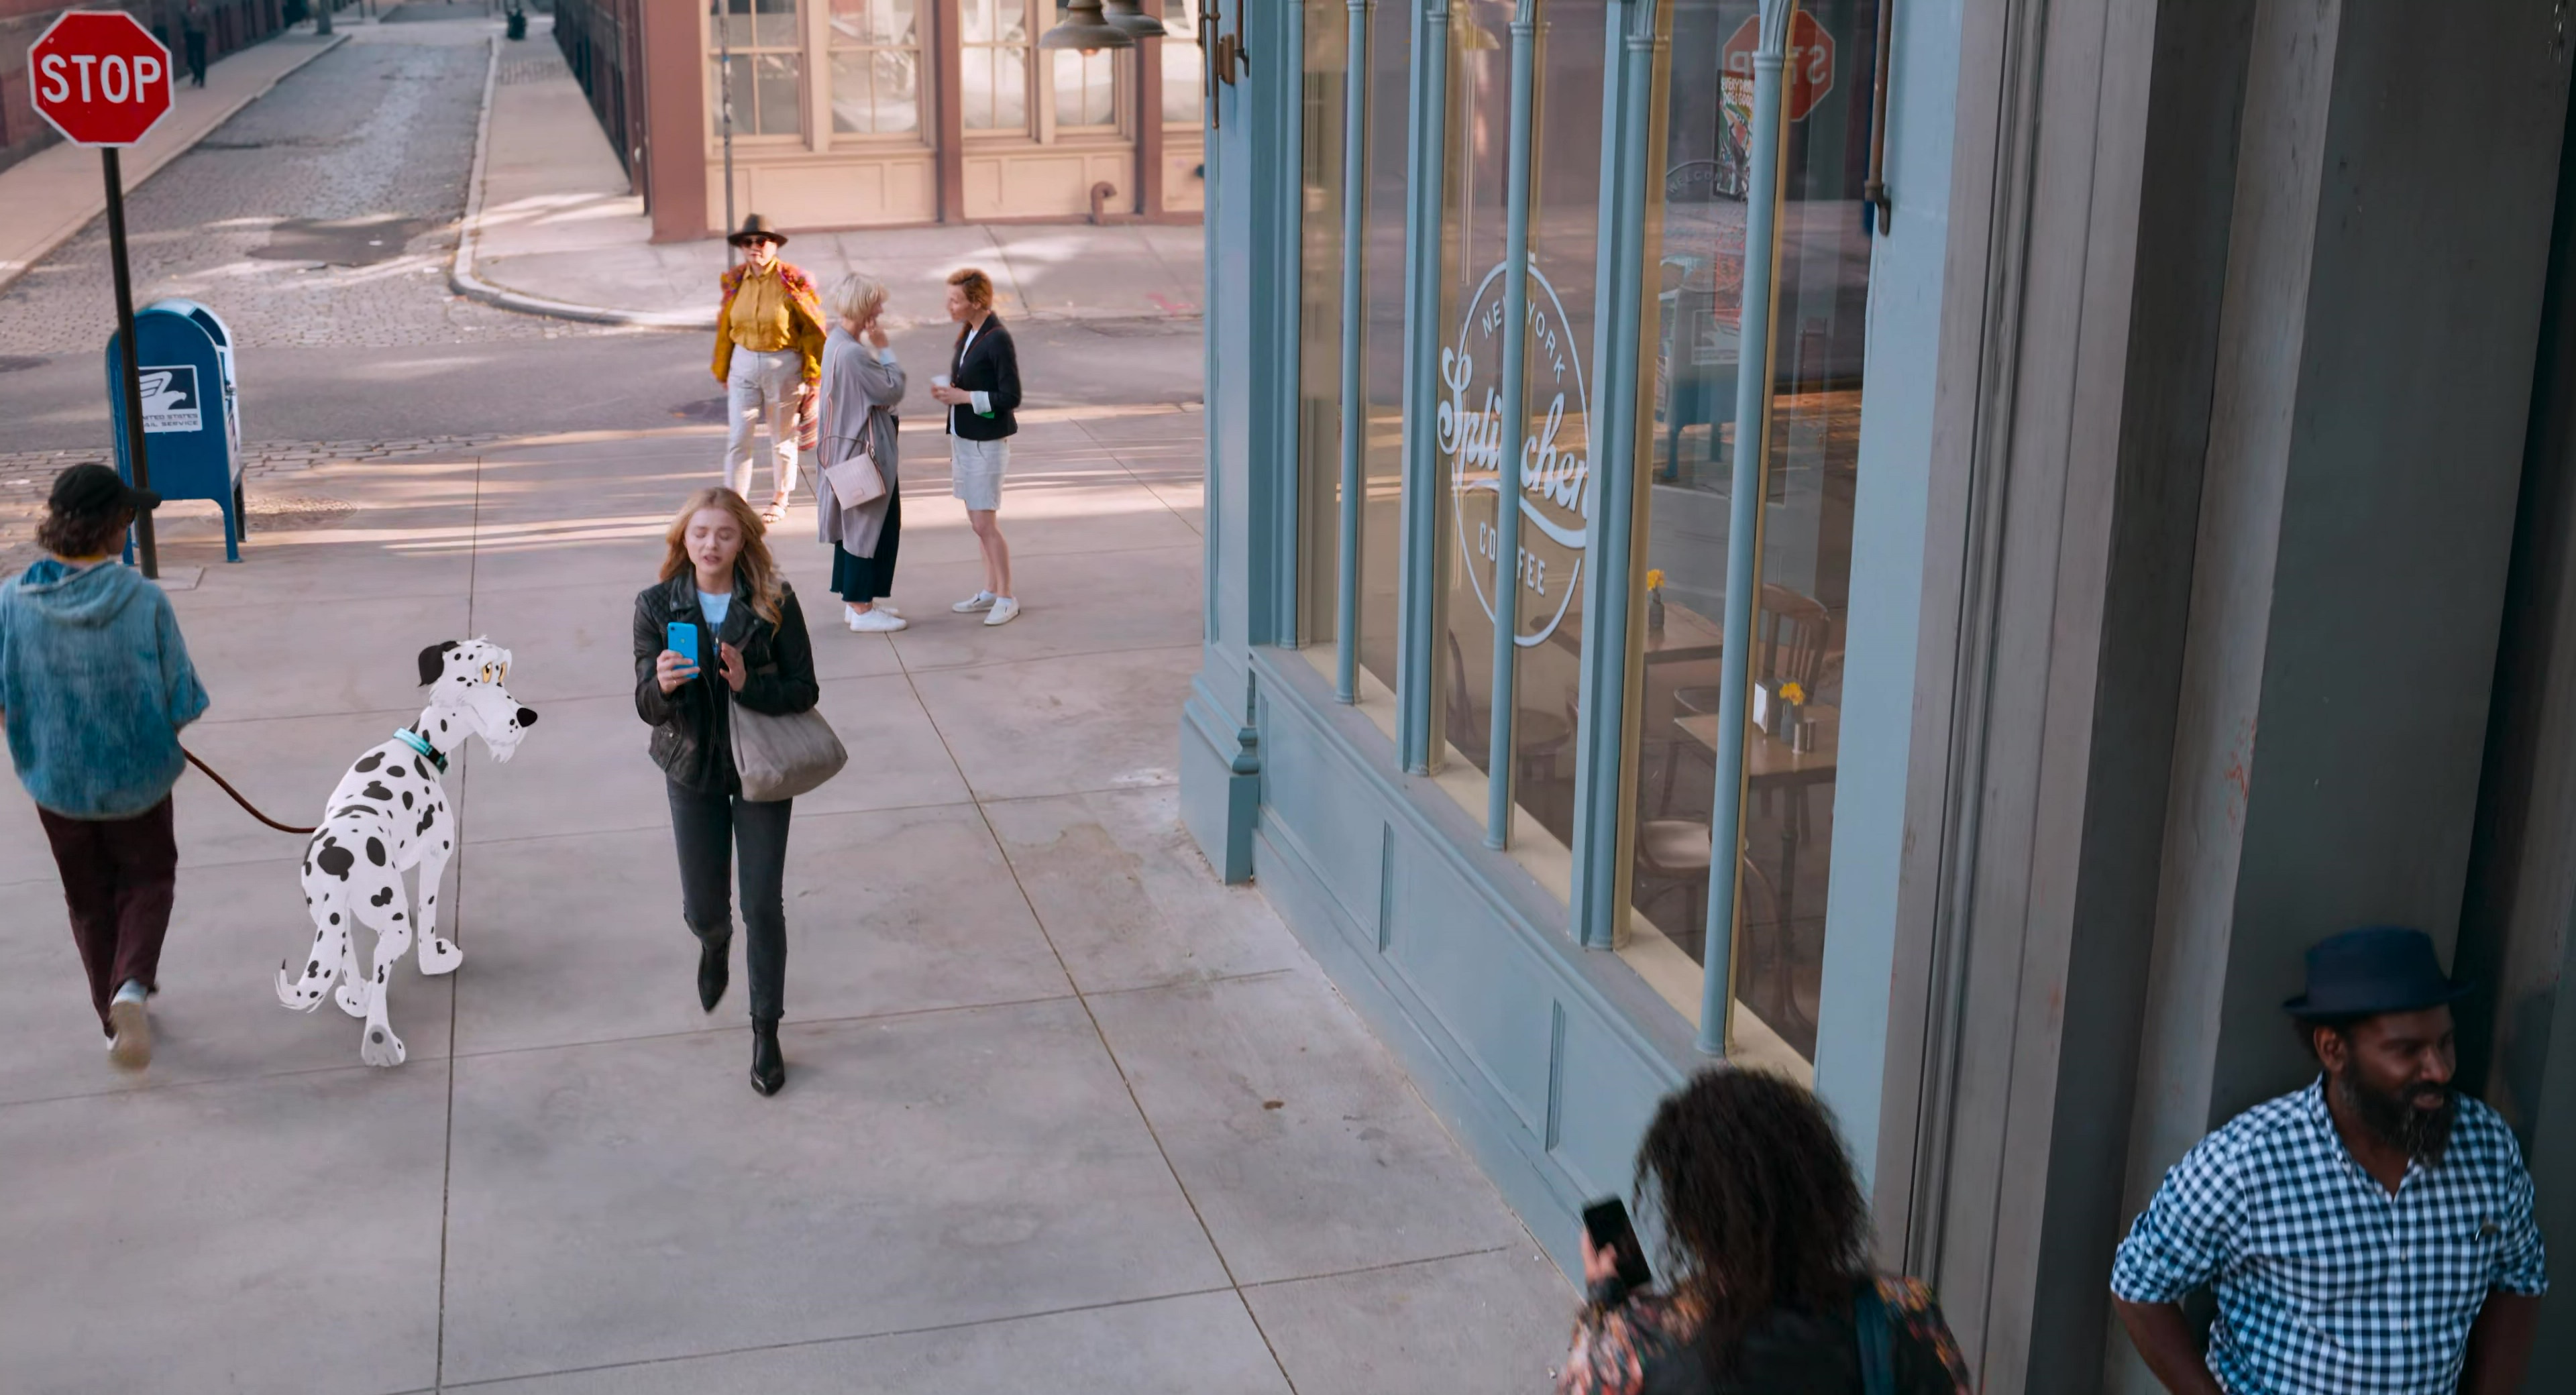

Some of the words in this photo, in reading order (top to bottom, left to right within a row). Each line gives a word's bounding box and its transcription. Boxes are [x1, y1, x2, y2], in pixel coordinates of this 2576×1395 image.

[40, 54, 162, 103] STOP
[1527, 298, 1565, 386] YORK
[1479, 521, 1546, 598] COFEE
